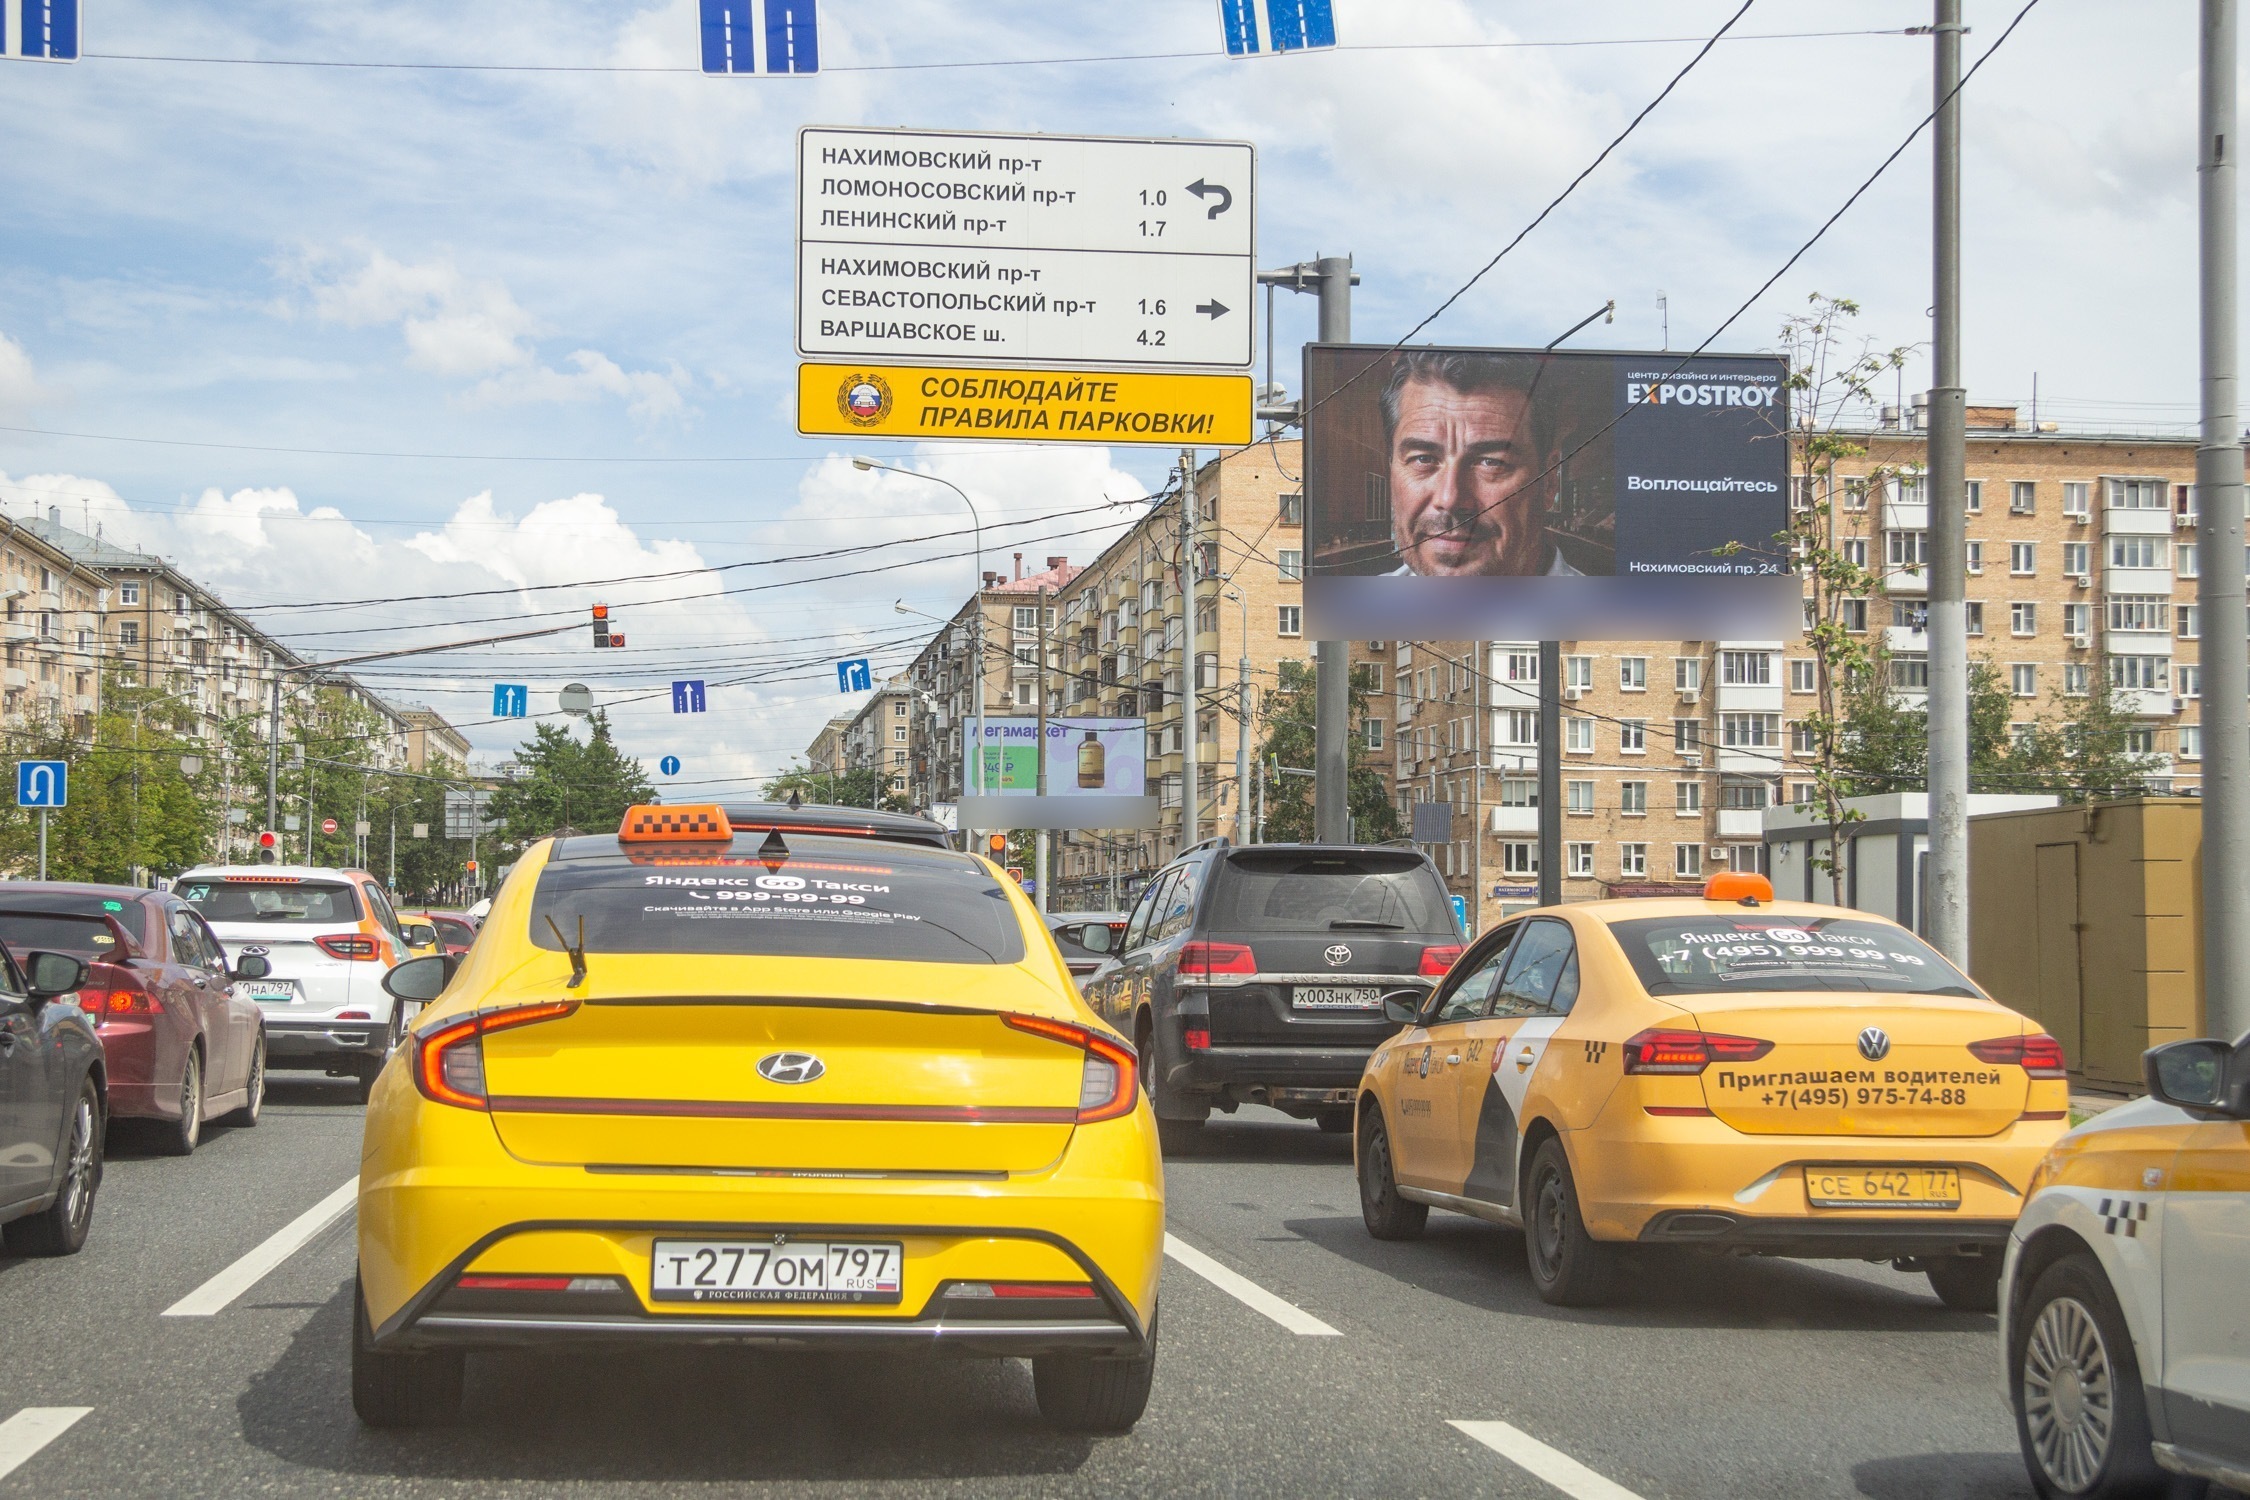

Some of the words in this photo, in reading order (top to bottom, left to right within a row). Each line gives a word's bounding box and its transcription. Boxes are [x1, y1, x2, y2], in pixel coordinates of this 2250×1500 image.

[823, 148, 990, 169] НАХИМОВСКИЙ
[999, 159, 1041, 174] пр-т
[821, 179, 1024, 201] ЛОМОНОСОВСКИЙ
[1034, 191, 1075, 206] пр-т
[1140, 190, 1166, 206] 1.0
[821, 210, 955, 230] ЛЕНИНСКИЙ
[964, 219, 1006, 235] пр-т
[1139, 221, 1166, 236] 1.7
[822, 258, 989, 279] НАХИМОВСКИЙ
[998, 269, 1040, 284] пр-т
[822, 289, 1045, 311] СЕВАСТОПОЛЬСКИЙ
[1054, 301, 1096, 316] пр-т
[1139, 299, 1166, 315] 1.6
[821, 320, 975, 340] ВАРШАВСКОЕ
[984, 330, 1005, 341] ш.
[1137, 330, 1165, 346] 4.2
[1627, 371, 1660, 380] центр
[1661, 372, 1709, 381] дизайна
[1710, 373, 1718, 381] и
[1719, 374, 1776, 382] интерьера
[920, 377, 1118, 404] СОБЛЮДАЙТЕ
[1627, 383, 1778, 407] EXPOSTROY
[920, 406, 1048, 430] ПРАВИЛА
[1059, 411, 1214, 433] ПАРКОВКИ!
[1627, 476, 1778, 494] Воплощайтесь
[1630, 561, 1731, 574] Нахимовский
[1735, 565, 1756, 576] пр.
[1760, 564, 1777, 575] 24
[645, 876, 748, 886] Яндекс
[811, 880, 889, 892] Такси
[716, 891, 866, 905] 999-99-99
[643, 904, 729, 914] Скачивайте
[742, 906, 771, 915] App
[774, 906, 811, 914] Store
[813, 908, 841, 916] или
[841, 909, 891, 920] Google
[892, 912, 922, 923] Play
[1680, 930, 1765, 946] Яндекс
[1814, 931, 1876, 946] Такси
[1657, 949, 1691, 963] +7
[1703, 945, 1783, 960] (495)
[1793, 946, 1844, 958] 999
[1848, 948, 1884, 961] 99
[1889, 952, 1926, 967] 99
[270, 982, 290, 993] 797
[1281, 974, 1319, 983] LAND
[1329, 975, 1397, 984] CRUISER
[1299, 989, 1352, 1004] Х003НК
[1355, 988, 1377, 1000] 750
[1466, 1039, 1483, 1062] 642
[1493, 1040, 1504, 1065] Я
[1719, 1071, 1875, 1091] Приглашаем
[1885, 1069, 2000, 1086] водителей
[1762, 1088, 1848, 1110] +7(495)
[1857, 1088, 1965, 1105] 975-74-88
[1820, 1177, 1852, 1195] СЕ
[1864, 1172, 1910, 1197] 642
[1923, 1170, 1949, 1190] 77
[1929, 1190, 1948, 1198] RUS
[670, 1248, 823, 1286] Т277ОМ
[832, 1248, 890, 1277] 797
[707, 1288, 780, 1300] РОССИЙСКАЯ
[784, 1290, 848, 1301] ФЕДЕРАЦИЯ
[845, 1277, 875, 1290] RUS
